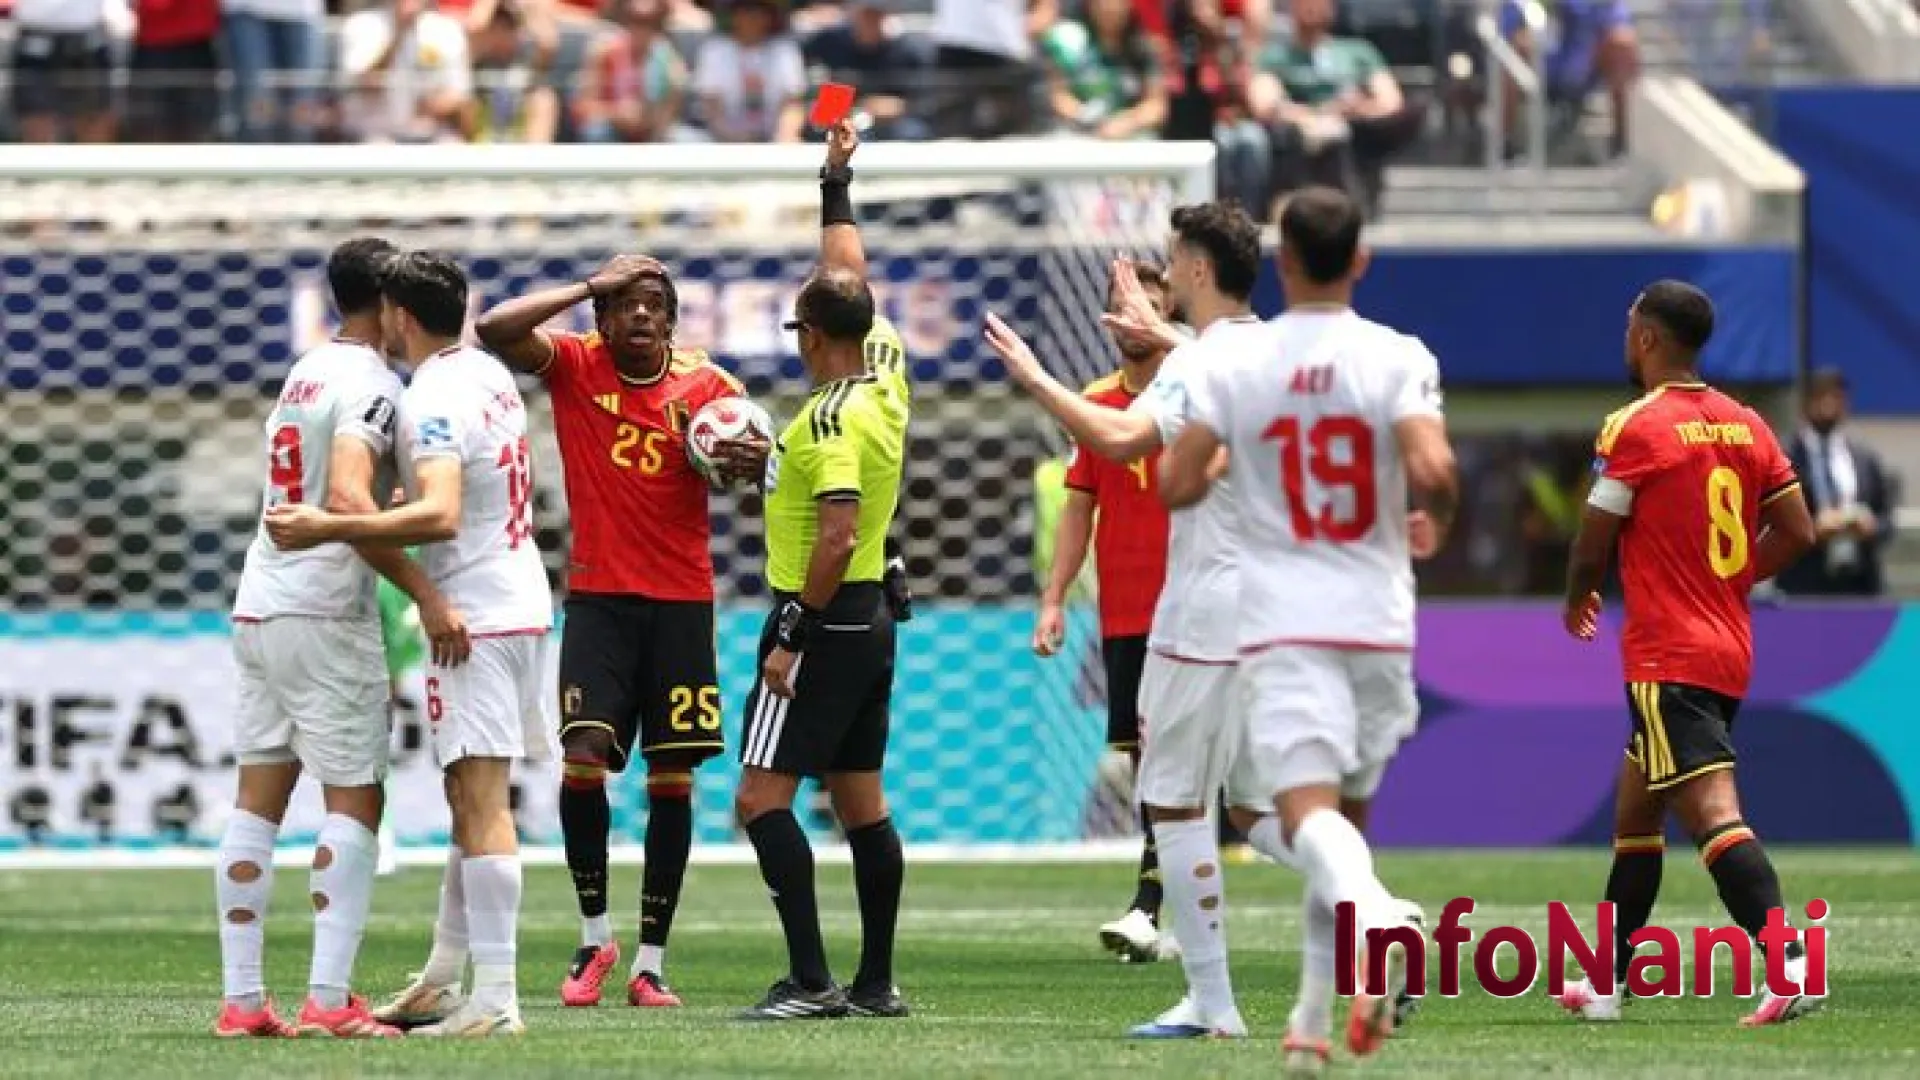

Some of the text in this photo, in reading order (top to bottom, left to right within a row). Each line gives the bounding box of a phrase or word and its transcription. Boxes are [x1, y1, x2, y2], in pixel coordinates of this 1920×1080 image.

[270, 425, 304, 504] 9
[611, 422, 666, 475] 25
[1260, 415, 1376, 545] 19
[1708, 466, 1748, 579] 8
[669, 686, 720, 731] 25
